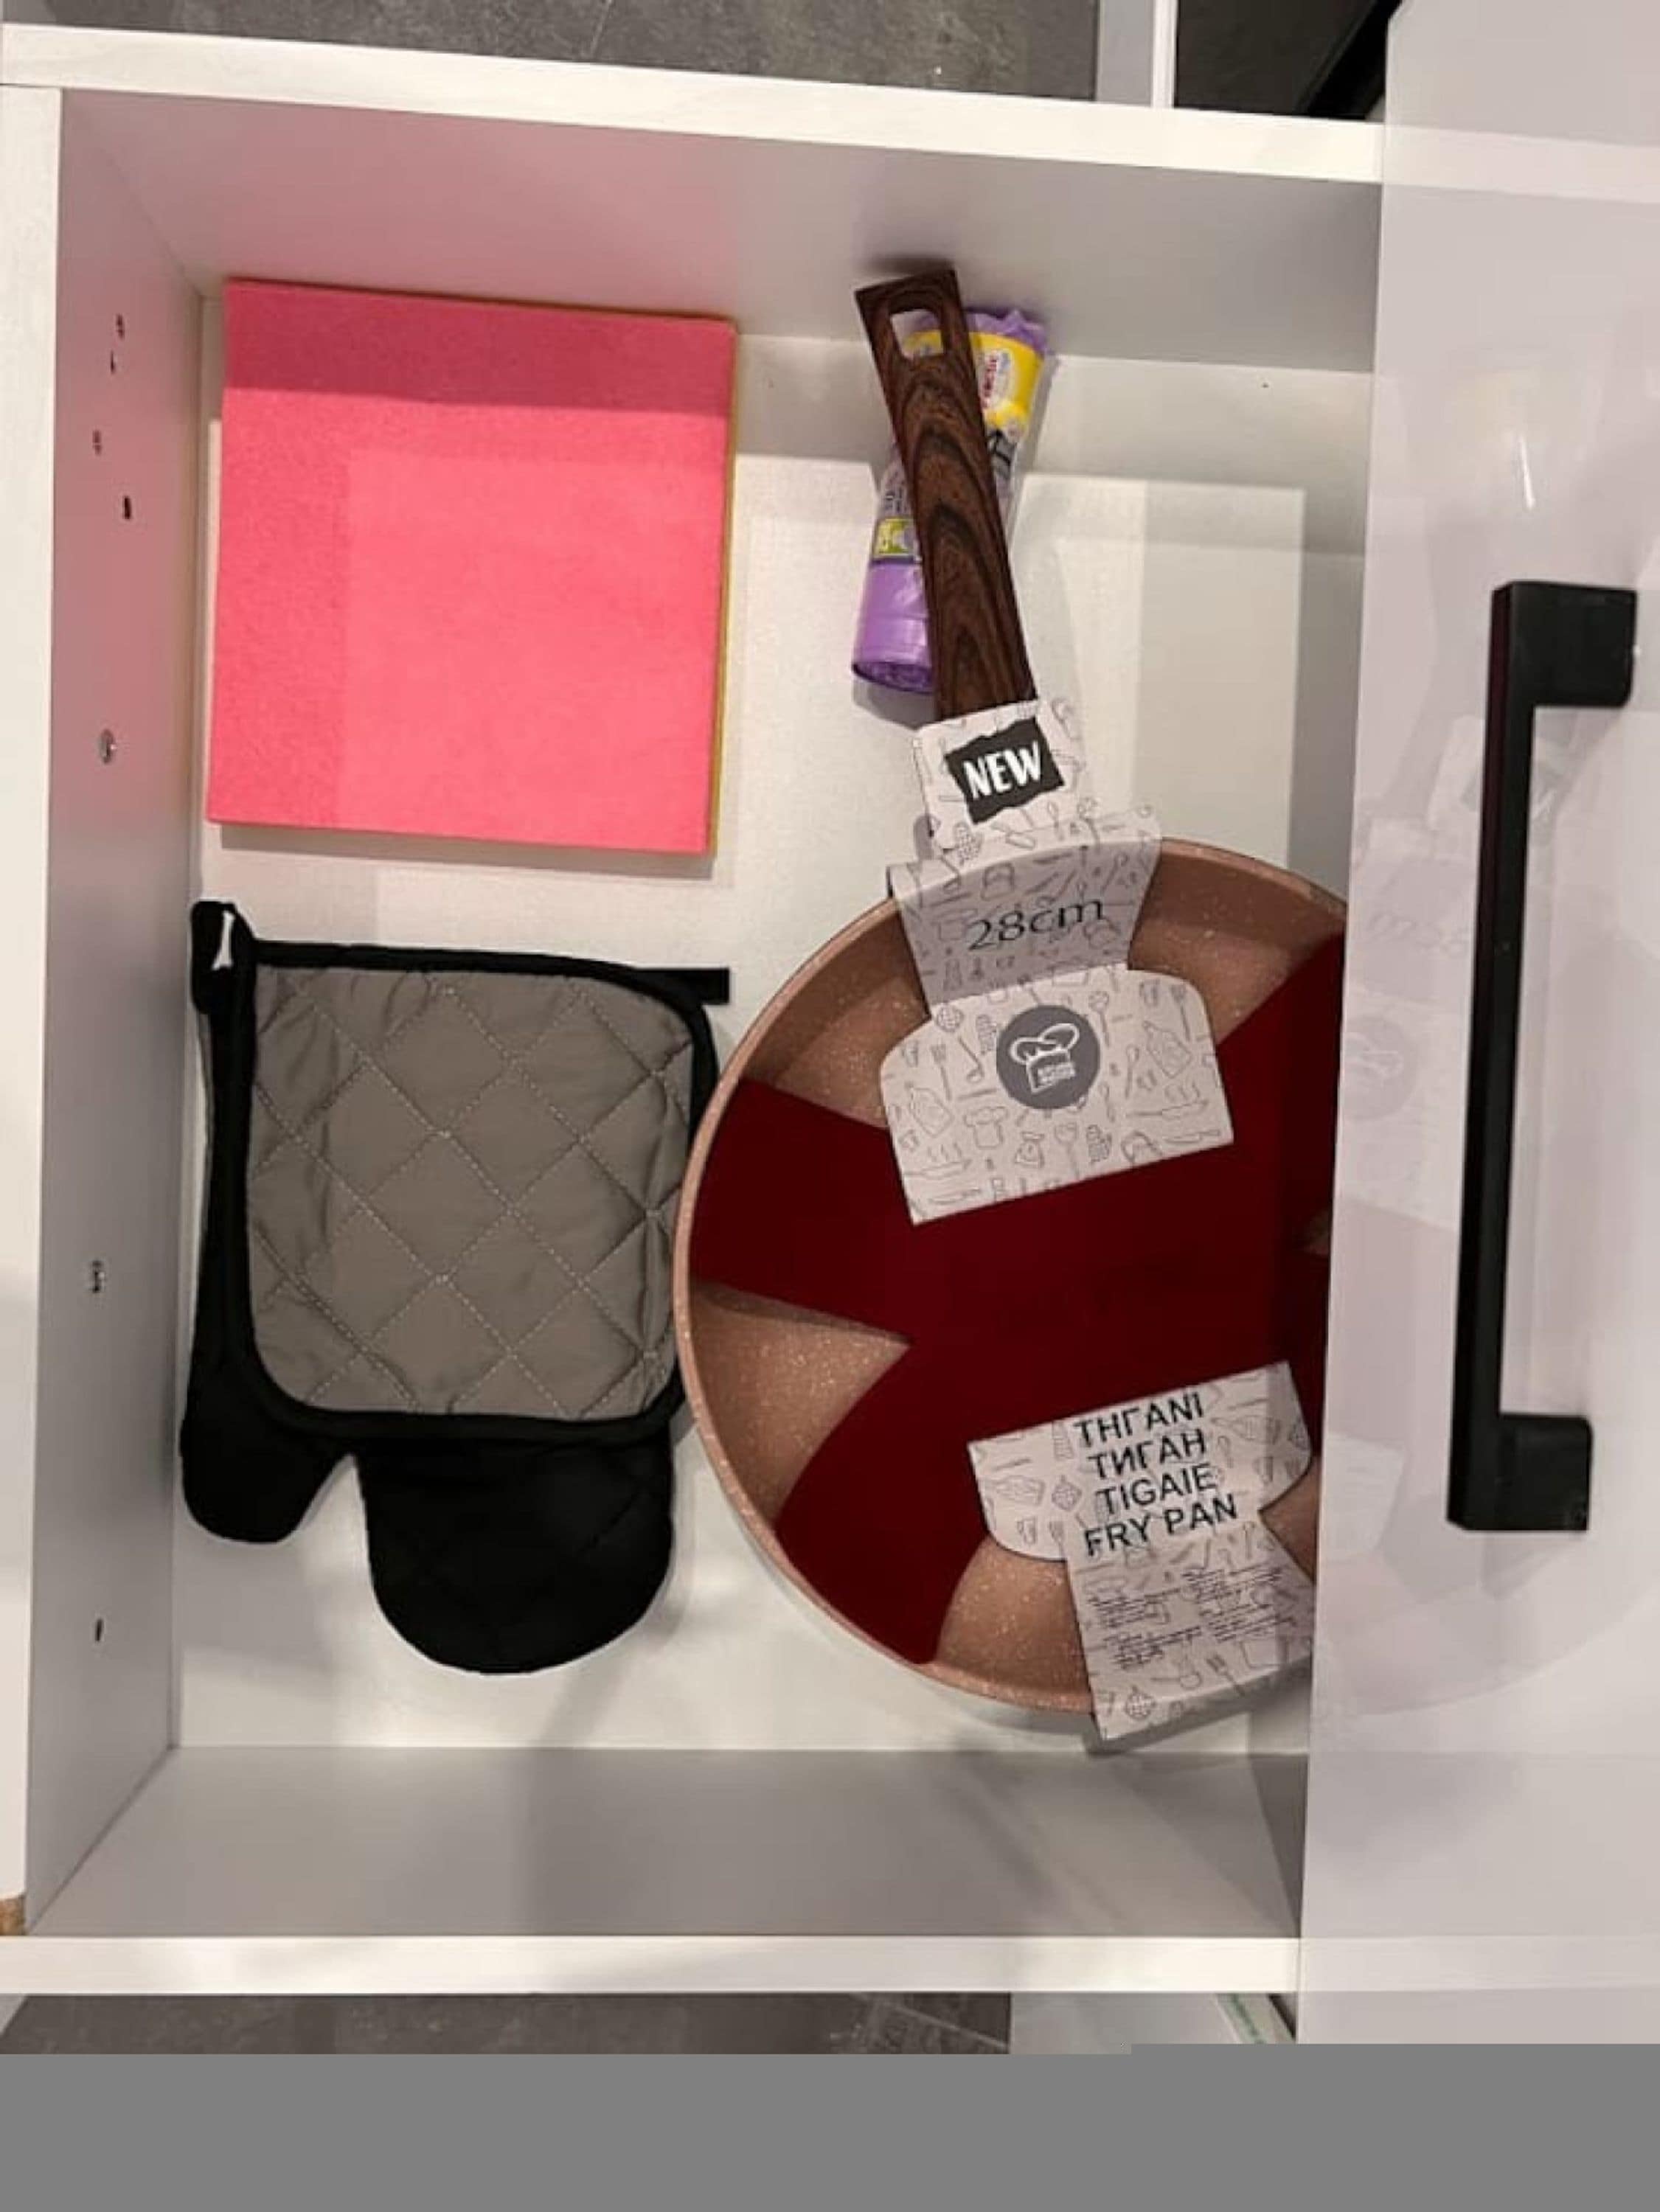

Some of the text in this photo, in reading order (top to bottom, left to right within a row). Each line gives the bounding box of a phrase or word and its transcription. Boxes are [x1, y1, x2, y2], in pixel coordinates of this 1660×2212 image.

[963, 740, 1041, 799] NEW
[968, 898, 1103, 951] 28cm
[1074, 1391, 1203, 1447] ΤΗΓΑΝΙ
[1088, 1428, 1205, 1478] ТИГАН
[1095, 1461, 1216, 1514] TIGAIE
[1084, 1493, 1237, 1557] FRY PAN
